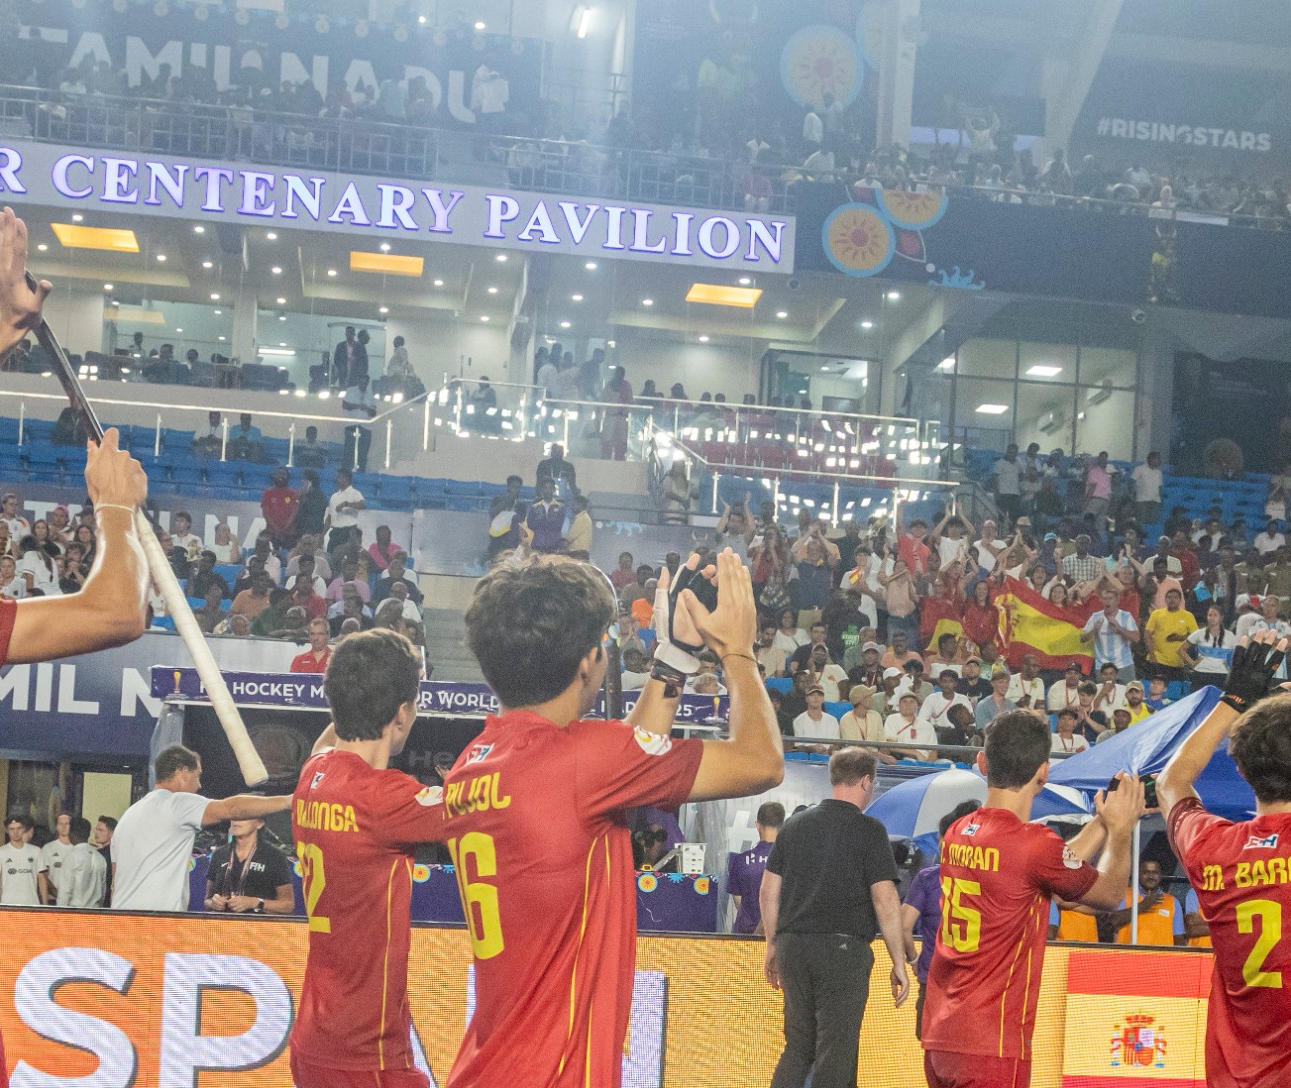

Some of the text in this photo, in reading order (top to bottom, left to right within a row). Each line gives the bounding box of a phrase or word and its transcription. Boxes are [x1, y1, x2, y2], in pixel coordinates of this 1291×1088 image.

[1097, 117, 1272, 152] #RISINGSTARS
[51, 153, 465, 234] CENTENARY
[483, 193, 787, 265] PAVILION
[232, 680, 306, 698] HOCKEY
[447, 831, 505, 960] 16
[941, 876, 982, 953] 15
[1235, 898, 1283, 989] 2
